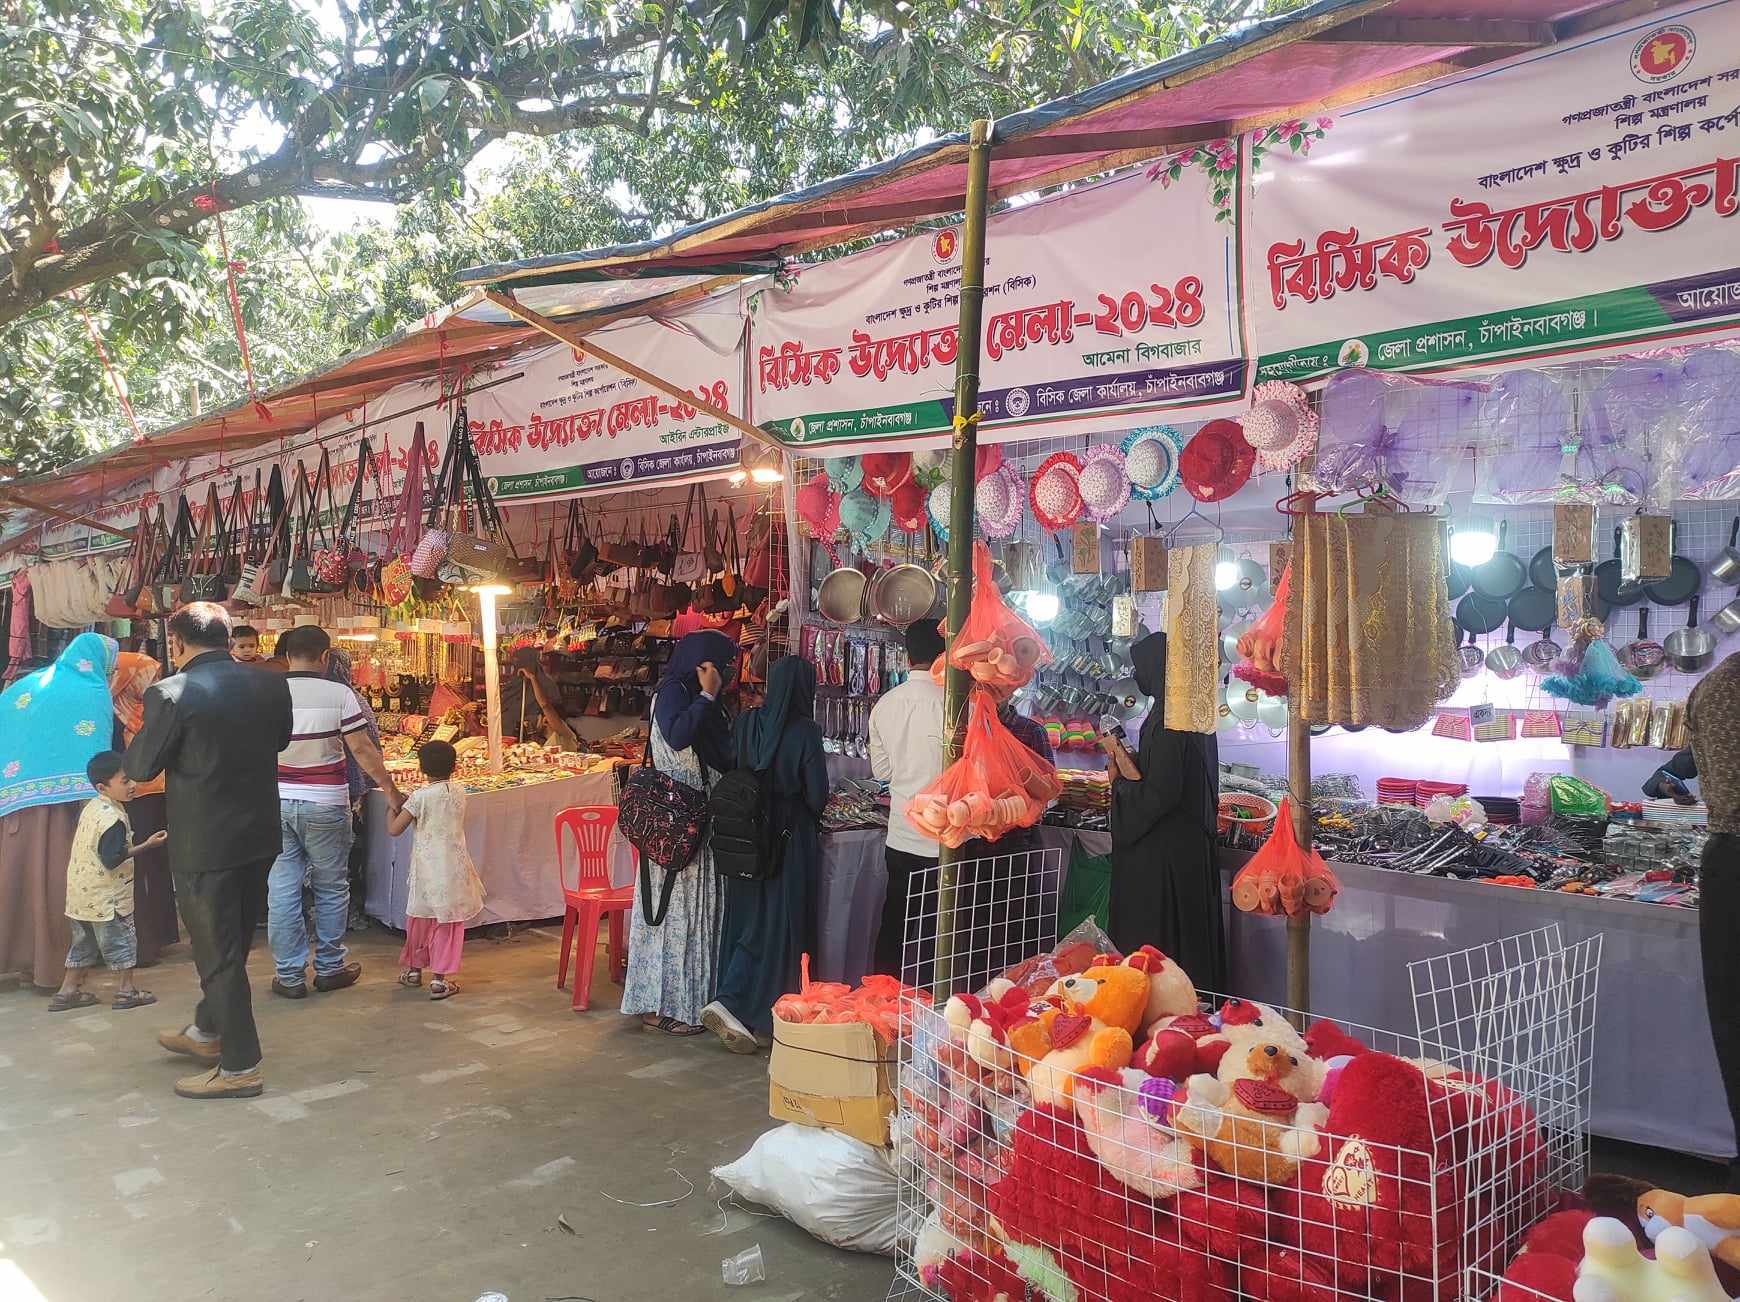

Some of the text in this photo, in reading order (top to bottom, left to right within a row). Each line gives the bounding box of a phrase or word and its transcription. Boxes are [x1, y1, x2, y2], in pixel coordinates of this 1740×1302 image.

[1641, 75, 1713, 104] বাংলাদেশ
[1614, 113, 1644, 130] শিল্প
[1478, 159, 1548, 190] বাংলাদেশ
[1587, 147, 1601, 161] ও
[1606, 132, 1652, 161] কুটির
[1655, 121, 1694, 146] শিল্প
[1266, 156, 1740, 311] বিসিক উদ্যোক্তা
[1081, 338, 1202, 368] আমেনা বিগবাজার
[1377, 337, 1411, 362] জেলা
[759, 339, 841, 393] বিসিক
[1036, 388, 1065, 408] বিসিক
[1068, 387, 1093, 404] জেলা
[808, 421, 825, 435] জেলা
